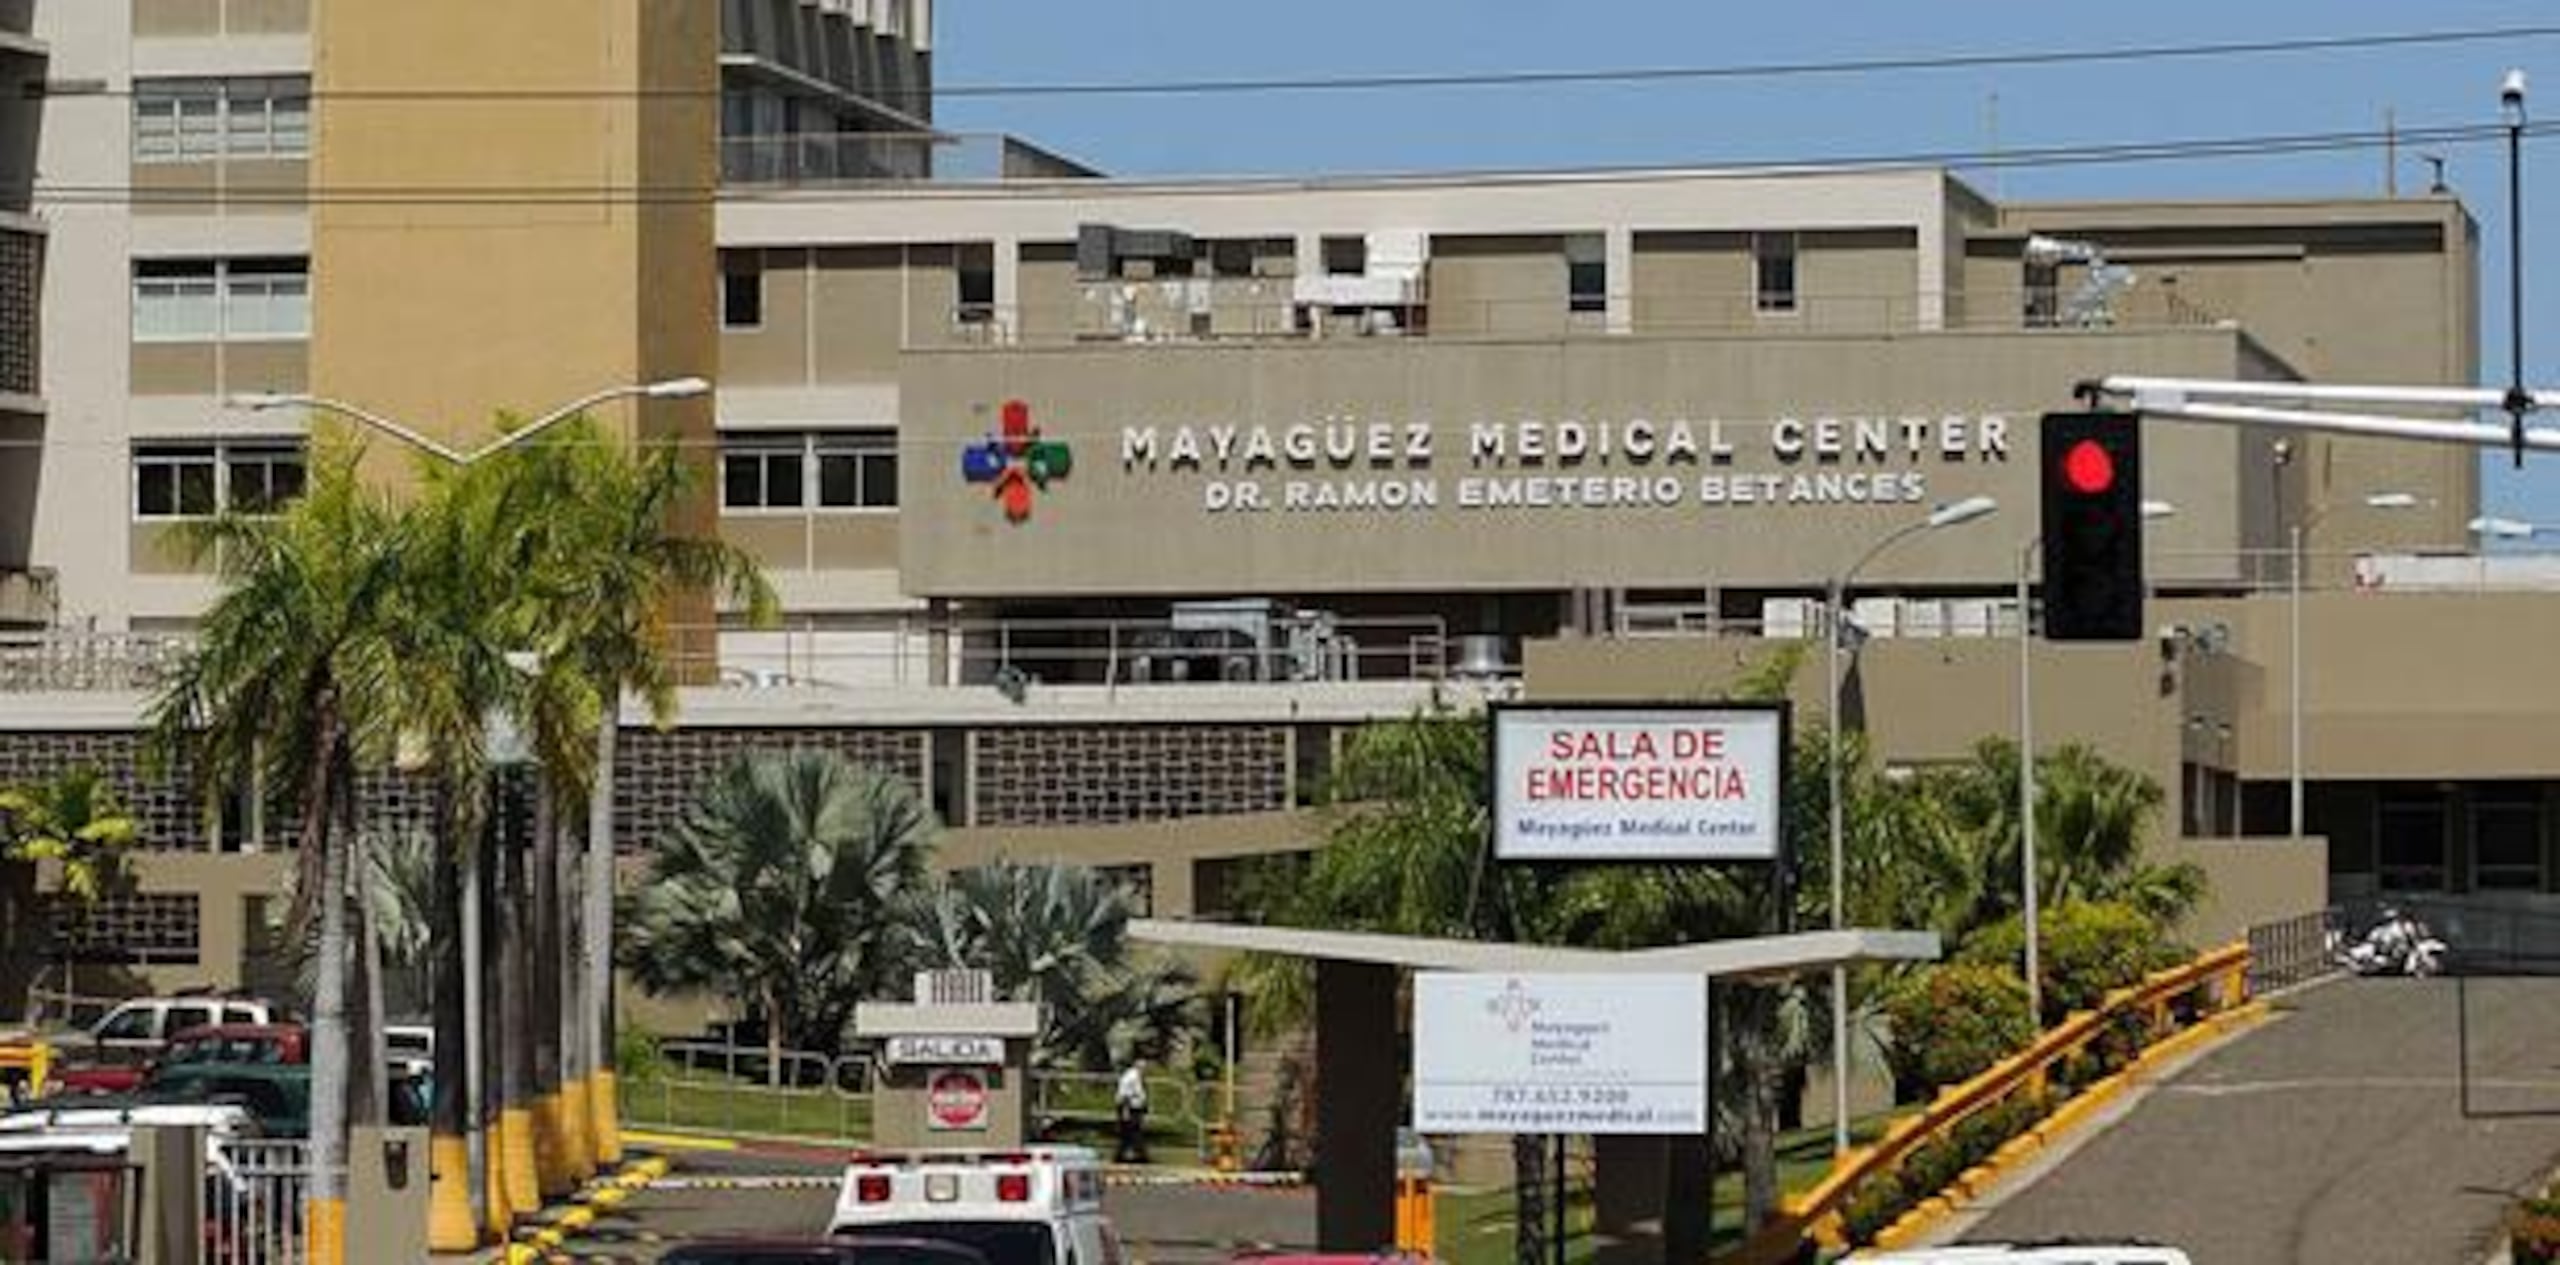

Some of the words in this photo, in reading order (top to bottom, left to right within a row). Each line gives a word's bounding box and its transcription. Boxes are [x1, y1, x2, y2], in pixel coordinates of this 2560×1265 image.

[1122, 415, 1434, 464] MAYAGÜEZ
[1470, 419, 1734, 461] MEDICAL
[1772, 415, 2010, 458] CENTER
[1206, 481, 1267, 510] DR.
[1285, 480, 1438, 510] RAMON
[1457, 476, 1682, 507] EMETERIO
[1700, 471, 1928, 502] BETANCES
[1552, 729, 1658, 760] SALA
[1673, 730, 1725, 759] DE
[1527, 766, 1746, 800] EMERGENCIA
[1620, 818, 1690, 836] Medical
[1698, 818, 1757, 836] Center
[900, 1039, 993, 1057] SALIDA
